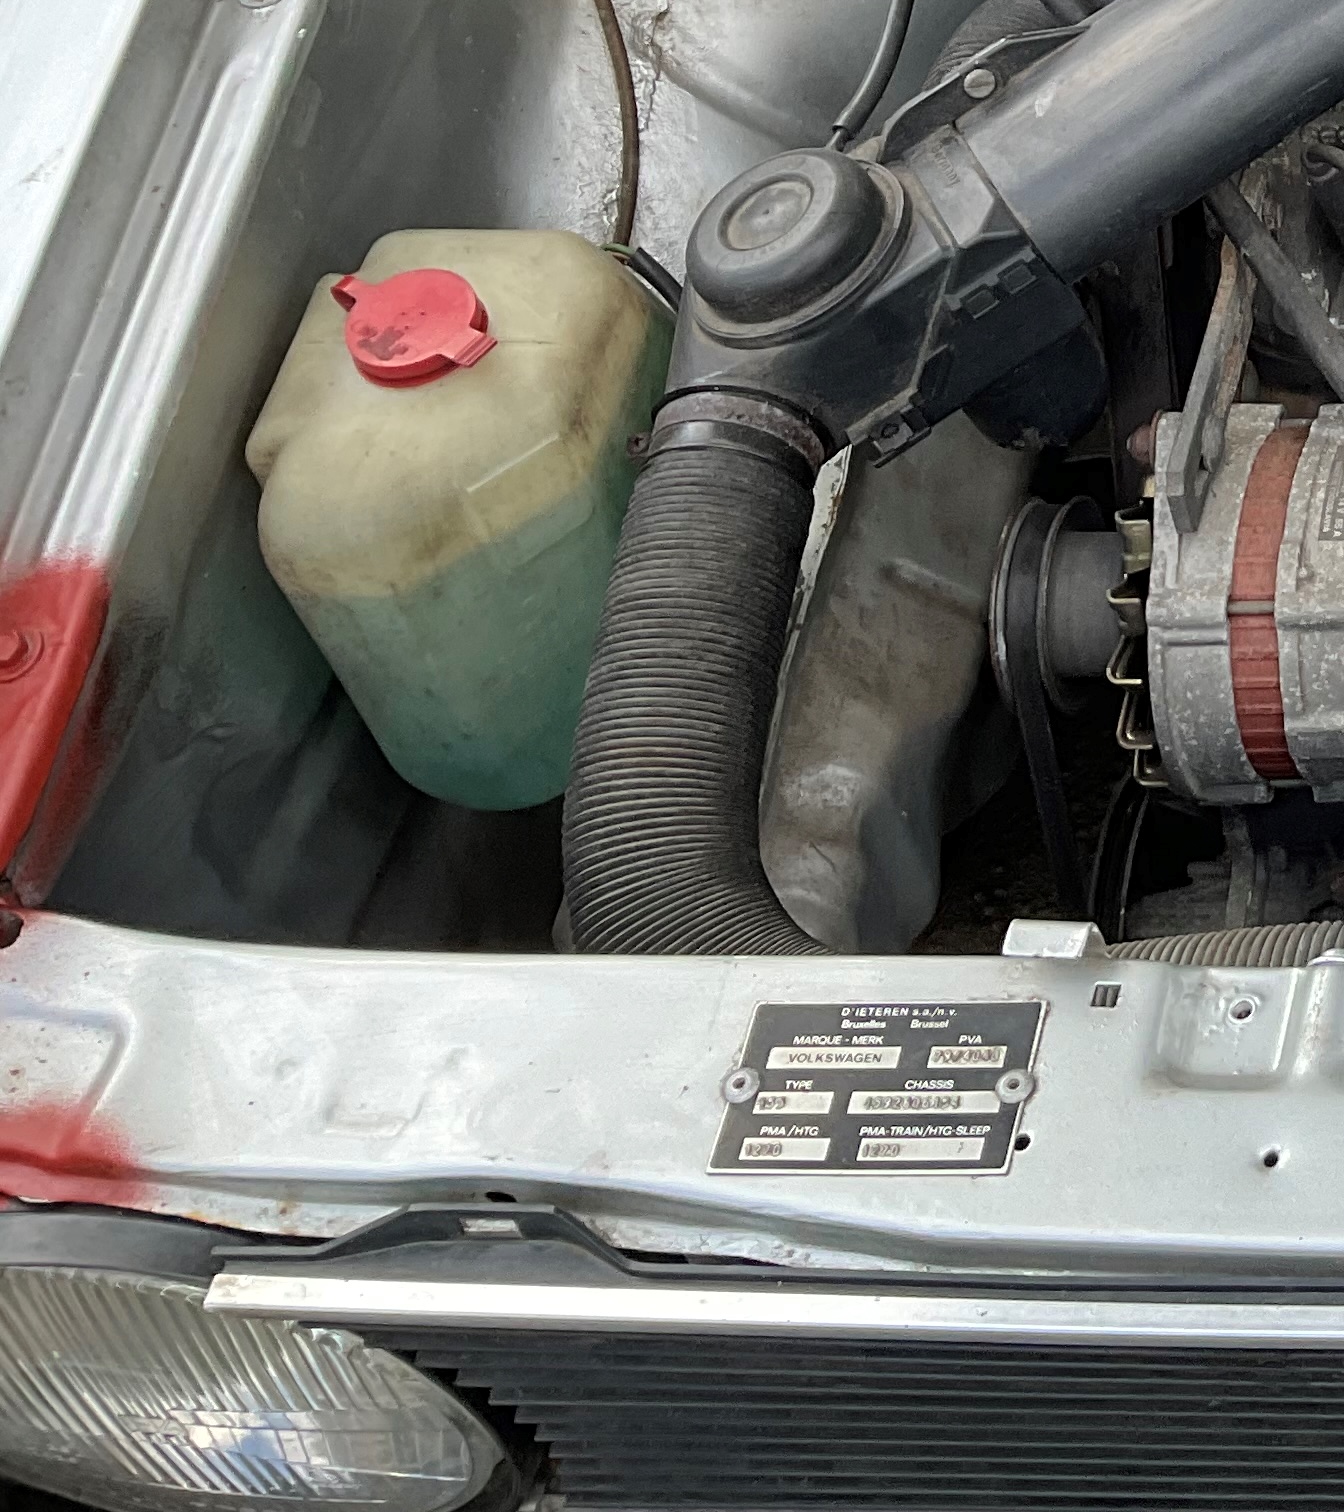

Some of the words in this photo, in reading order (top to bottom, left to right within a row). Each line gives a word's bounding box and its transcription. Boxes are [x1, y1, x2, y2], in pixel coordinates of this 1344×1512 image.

[841, 1007, 910, 1017] D'IETEREN
[840, 1019, 887, 1029] Bruxelles
[910, 1018, 950, 1029] Brussel
[792, 1035, 843, 1045] MARQUE
[852, 1035, 885, 1045] MERK
[958, 1034, 983, 1044] PVA
[788, 1052, 883, 1064] VOLKSWAGEN
[785, 1079, 814, 1090] TYPE
[904, 1079, 955, 1090] CHASSIS
